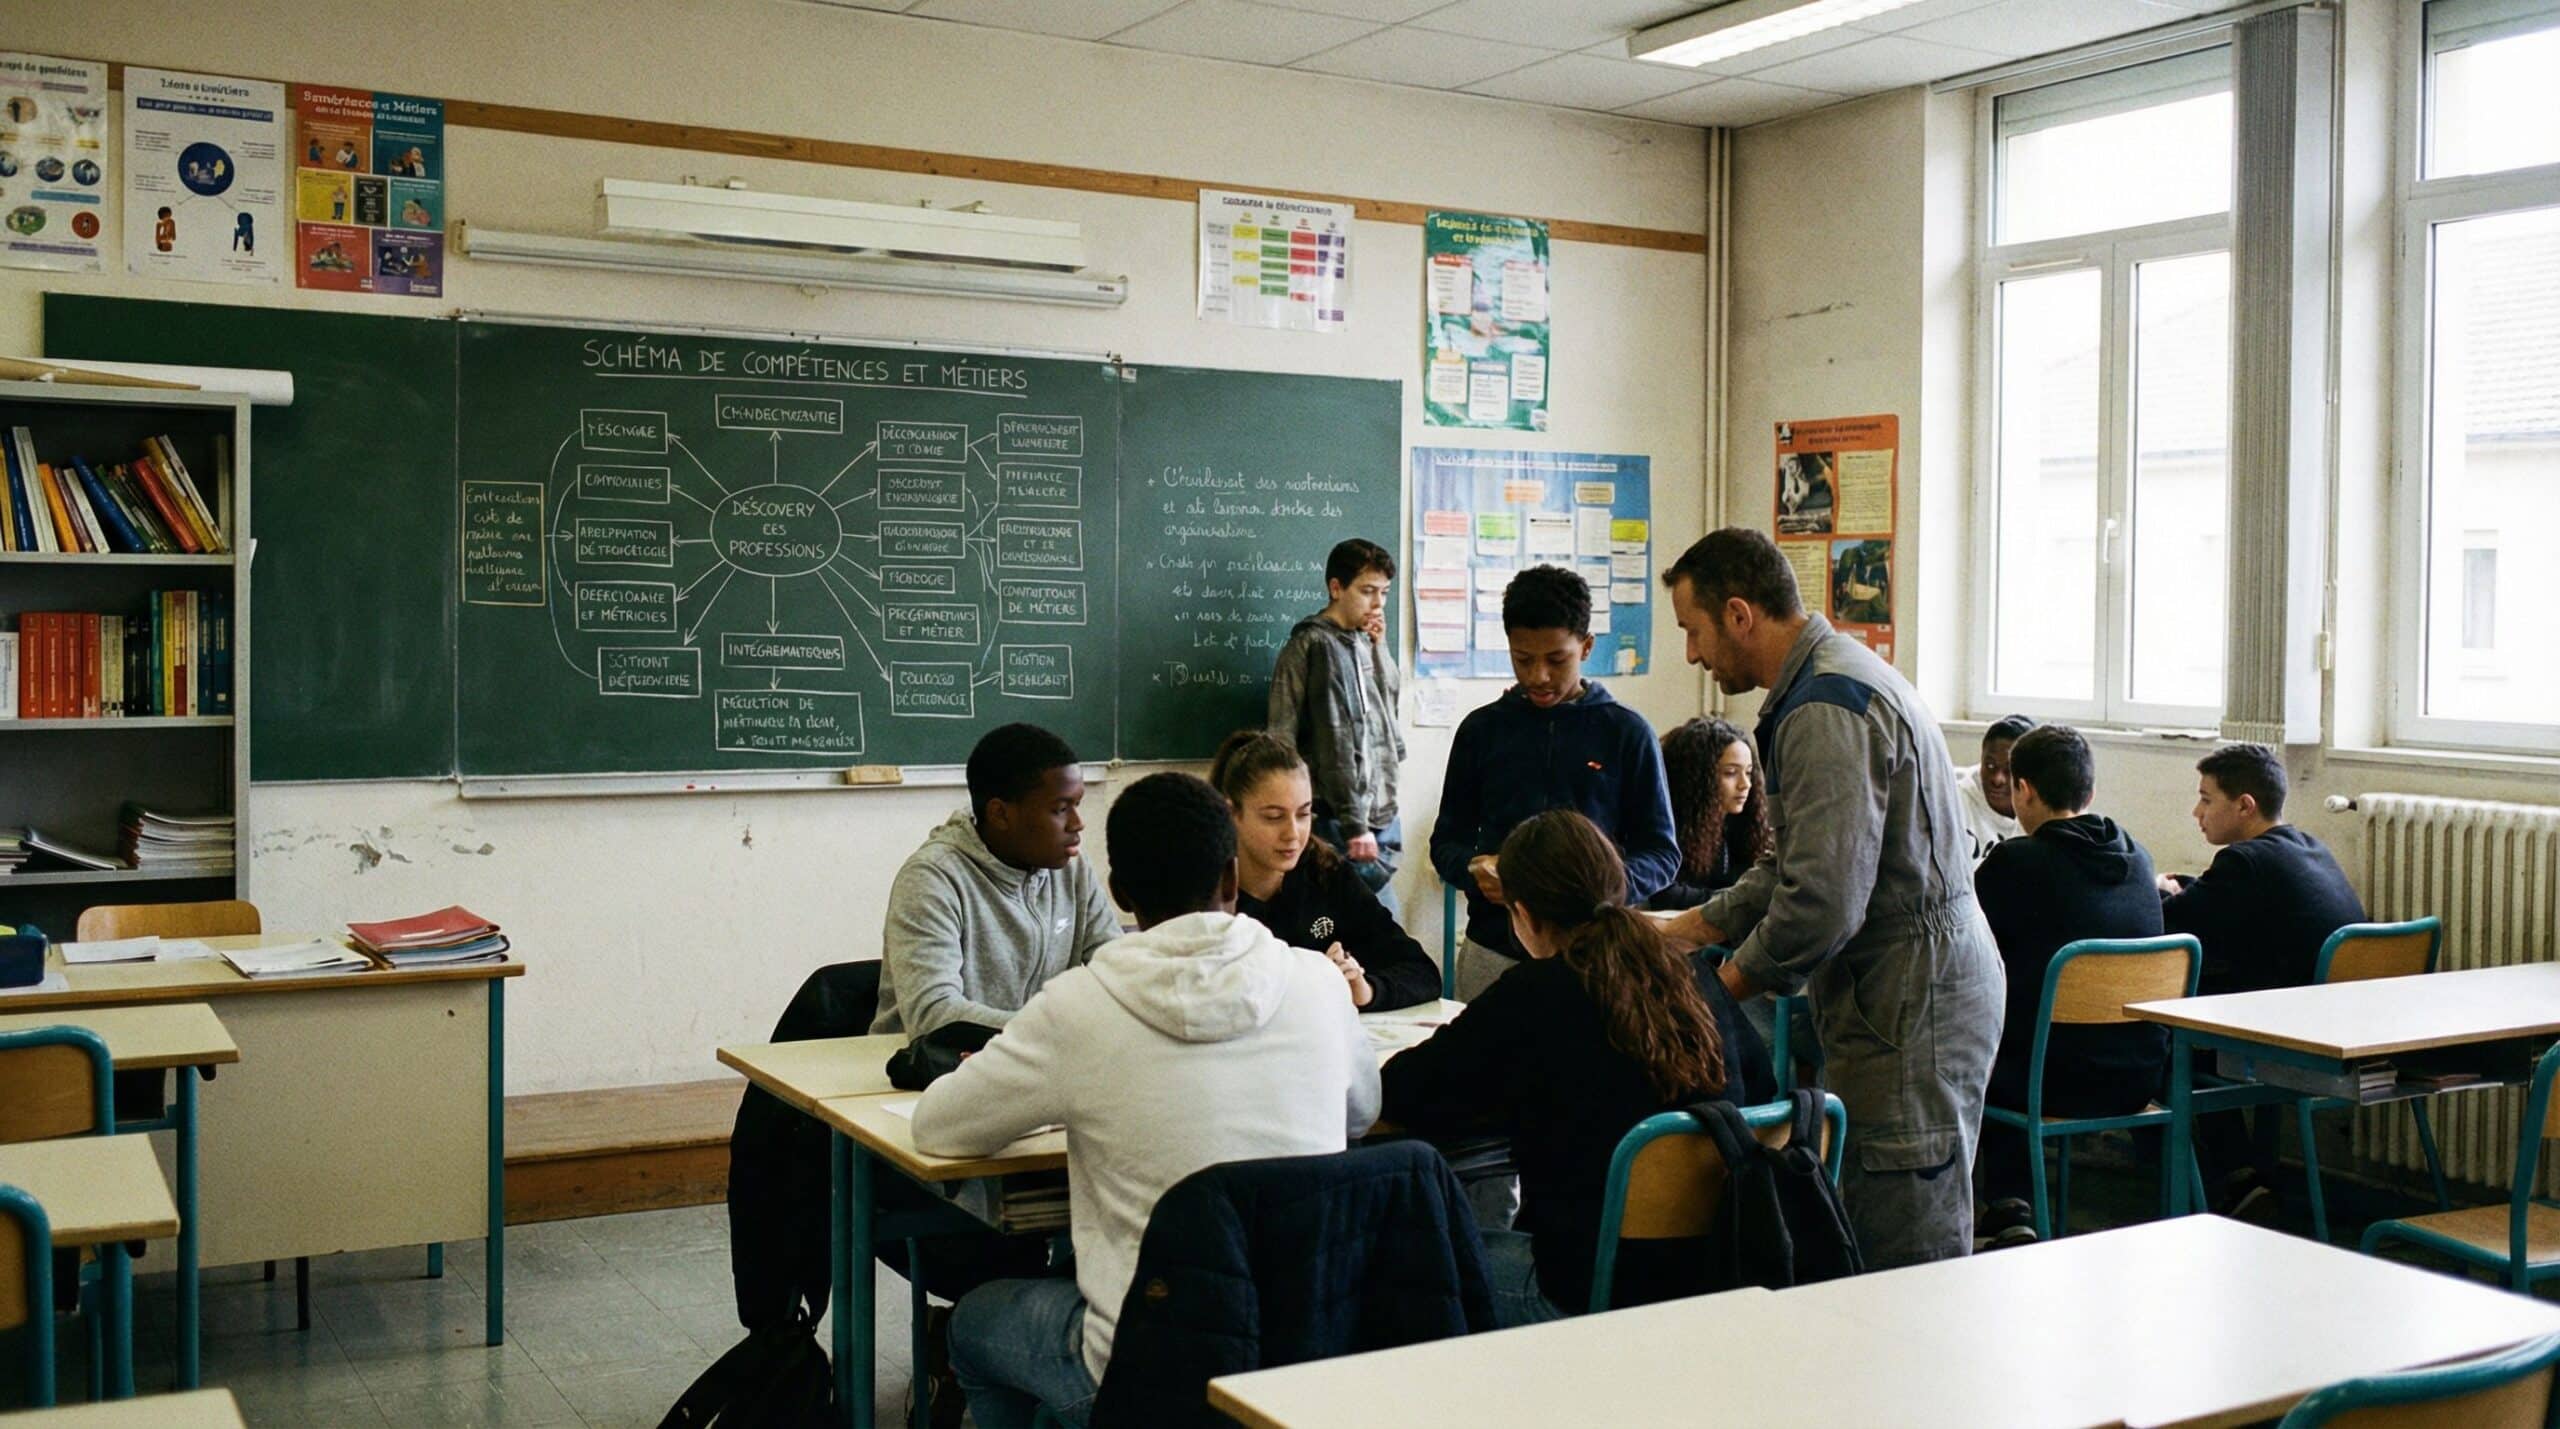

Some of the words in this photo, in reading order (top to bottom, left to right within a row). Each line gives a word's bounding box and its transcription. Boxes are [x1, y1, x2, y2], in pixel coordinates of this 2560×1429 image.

[583, 336, 682, 371] SCHÉMA
[698, 350, 726, 372] DE
[742, 348, 889, 381] COMPÉTENCES
[903, 364, 928, 383] ET
[942, 358, 1027, 389] MÉTIERS
[729, 540, 825, 560] PROFESSIONS
